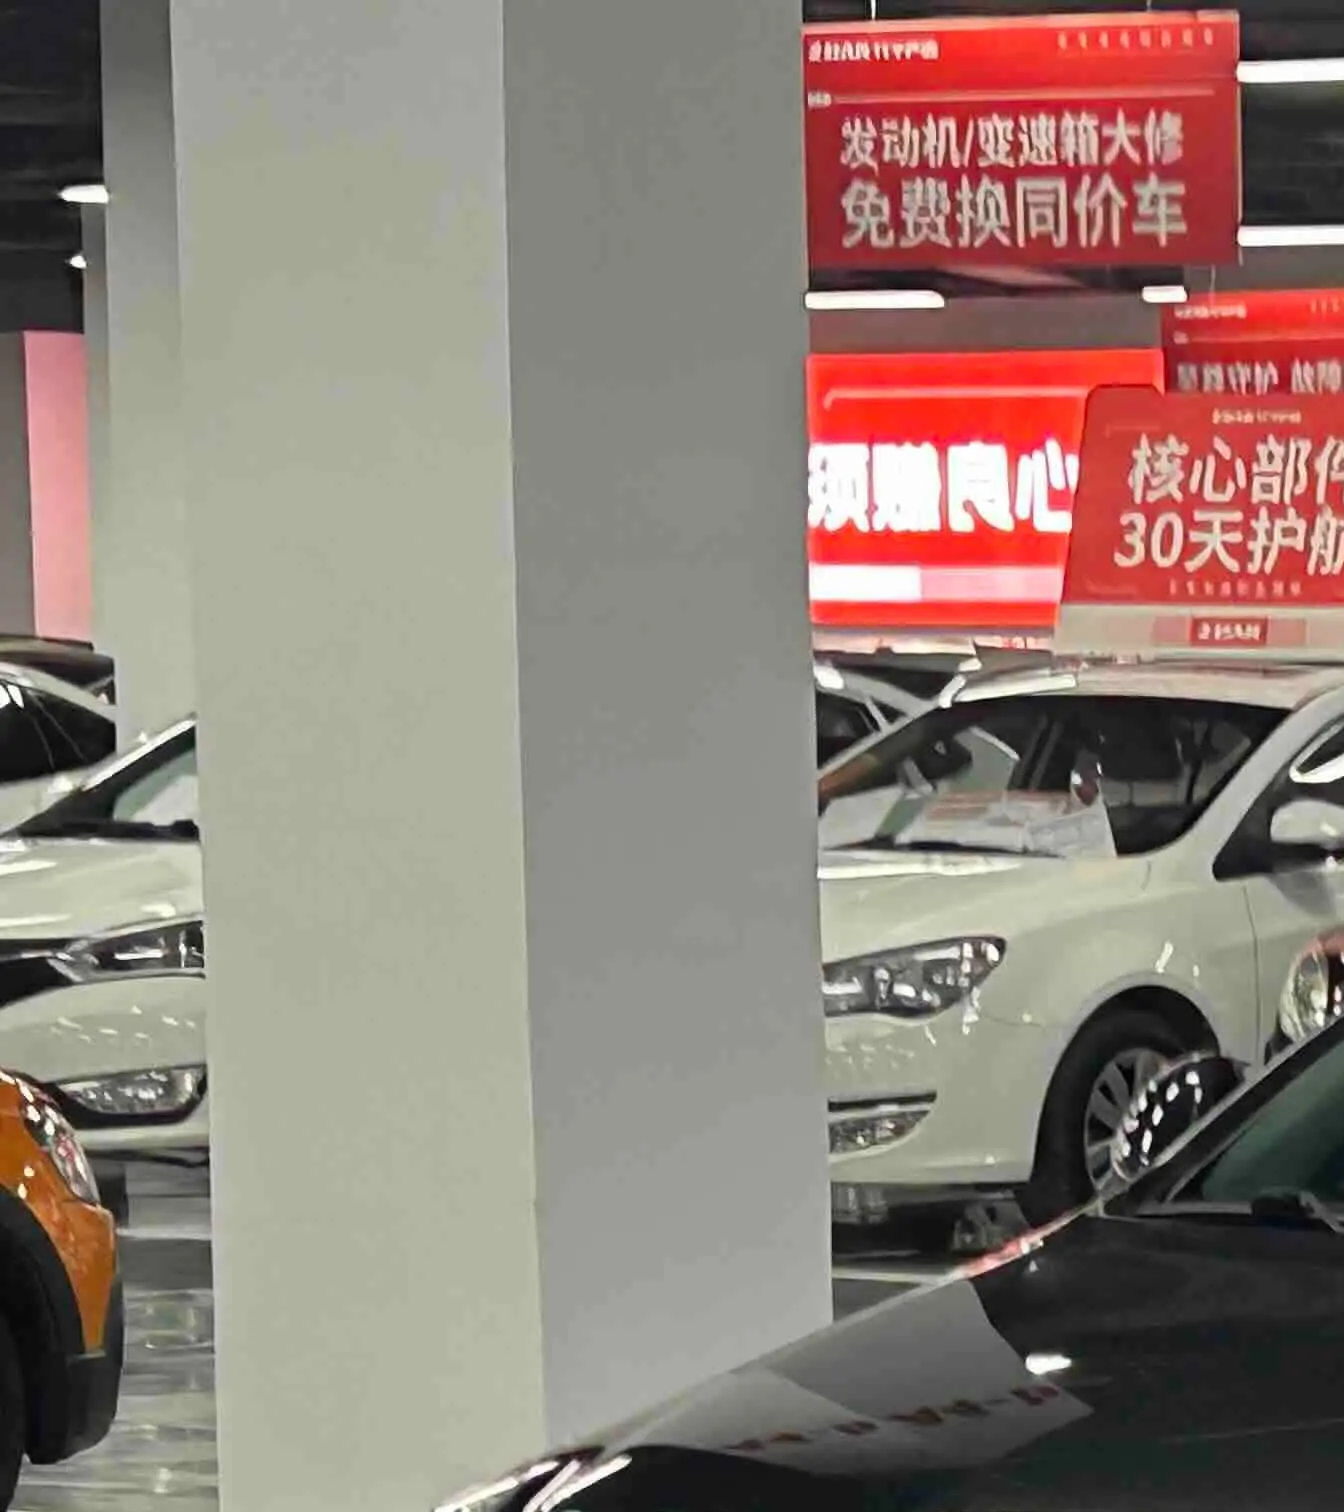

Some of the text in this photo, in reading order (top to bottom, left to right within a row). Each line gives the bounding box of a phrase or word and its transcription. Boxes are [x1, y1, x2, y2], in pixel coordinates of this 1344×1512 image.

[840, 107, 1184, 175] 发动机/变速箱大修
[841, 172, 1188, 249] 免费换同价车
